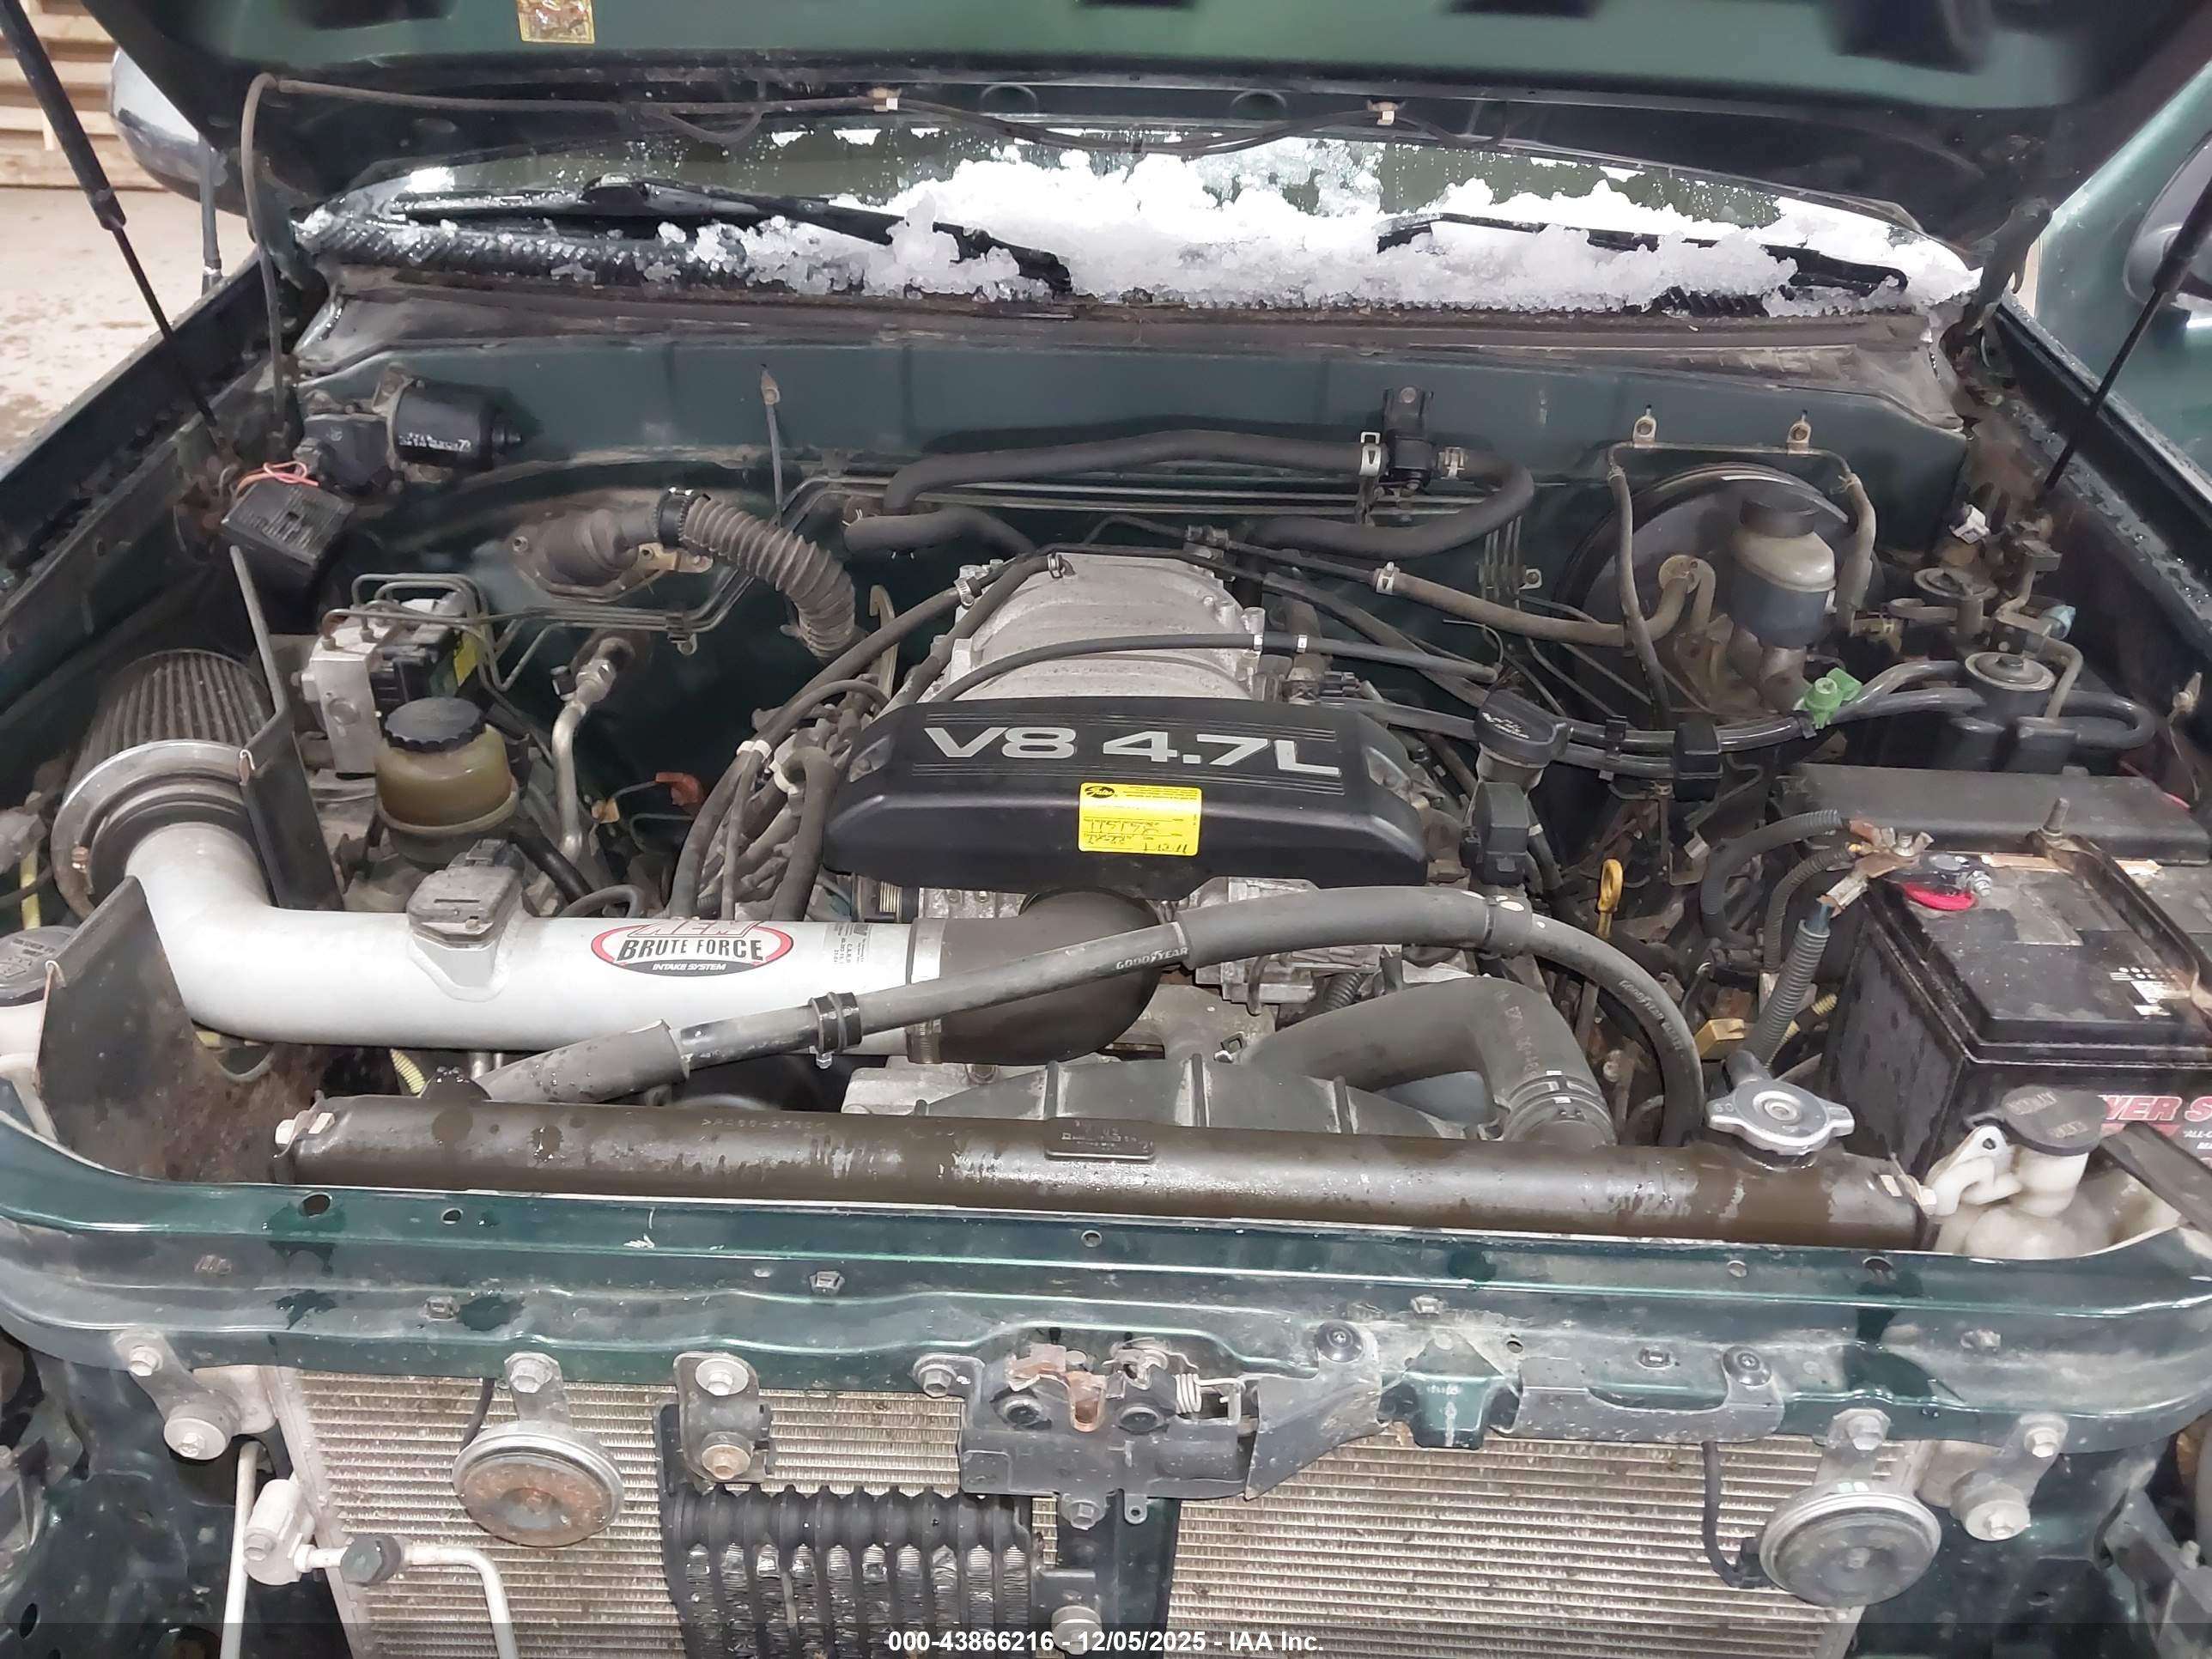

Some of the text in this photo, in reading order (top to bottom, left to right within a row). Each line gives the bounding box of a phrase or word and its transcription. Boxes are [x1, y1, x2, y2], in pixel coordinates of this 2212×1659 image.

[924, 726, 1342, 777] V8 4.7L
[617, 939, 763, 961] BRUTE FORCE
[1116, 947, 1188, 969] GOODYEAR
[652, 963, 727, 971] INTAKE SYSTEM
